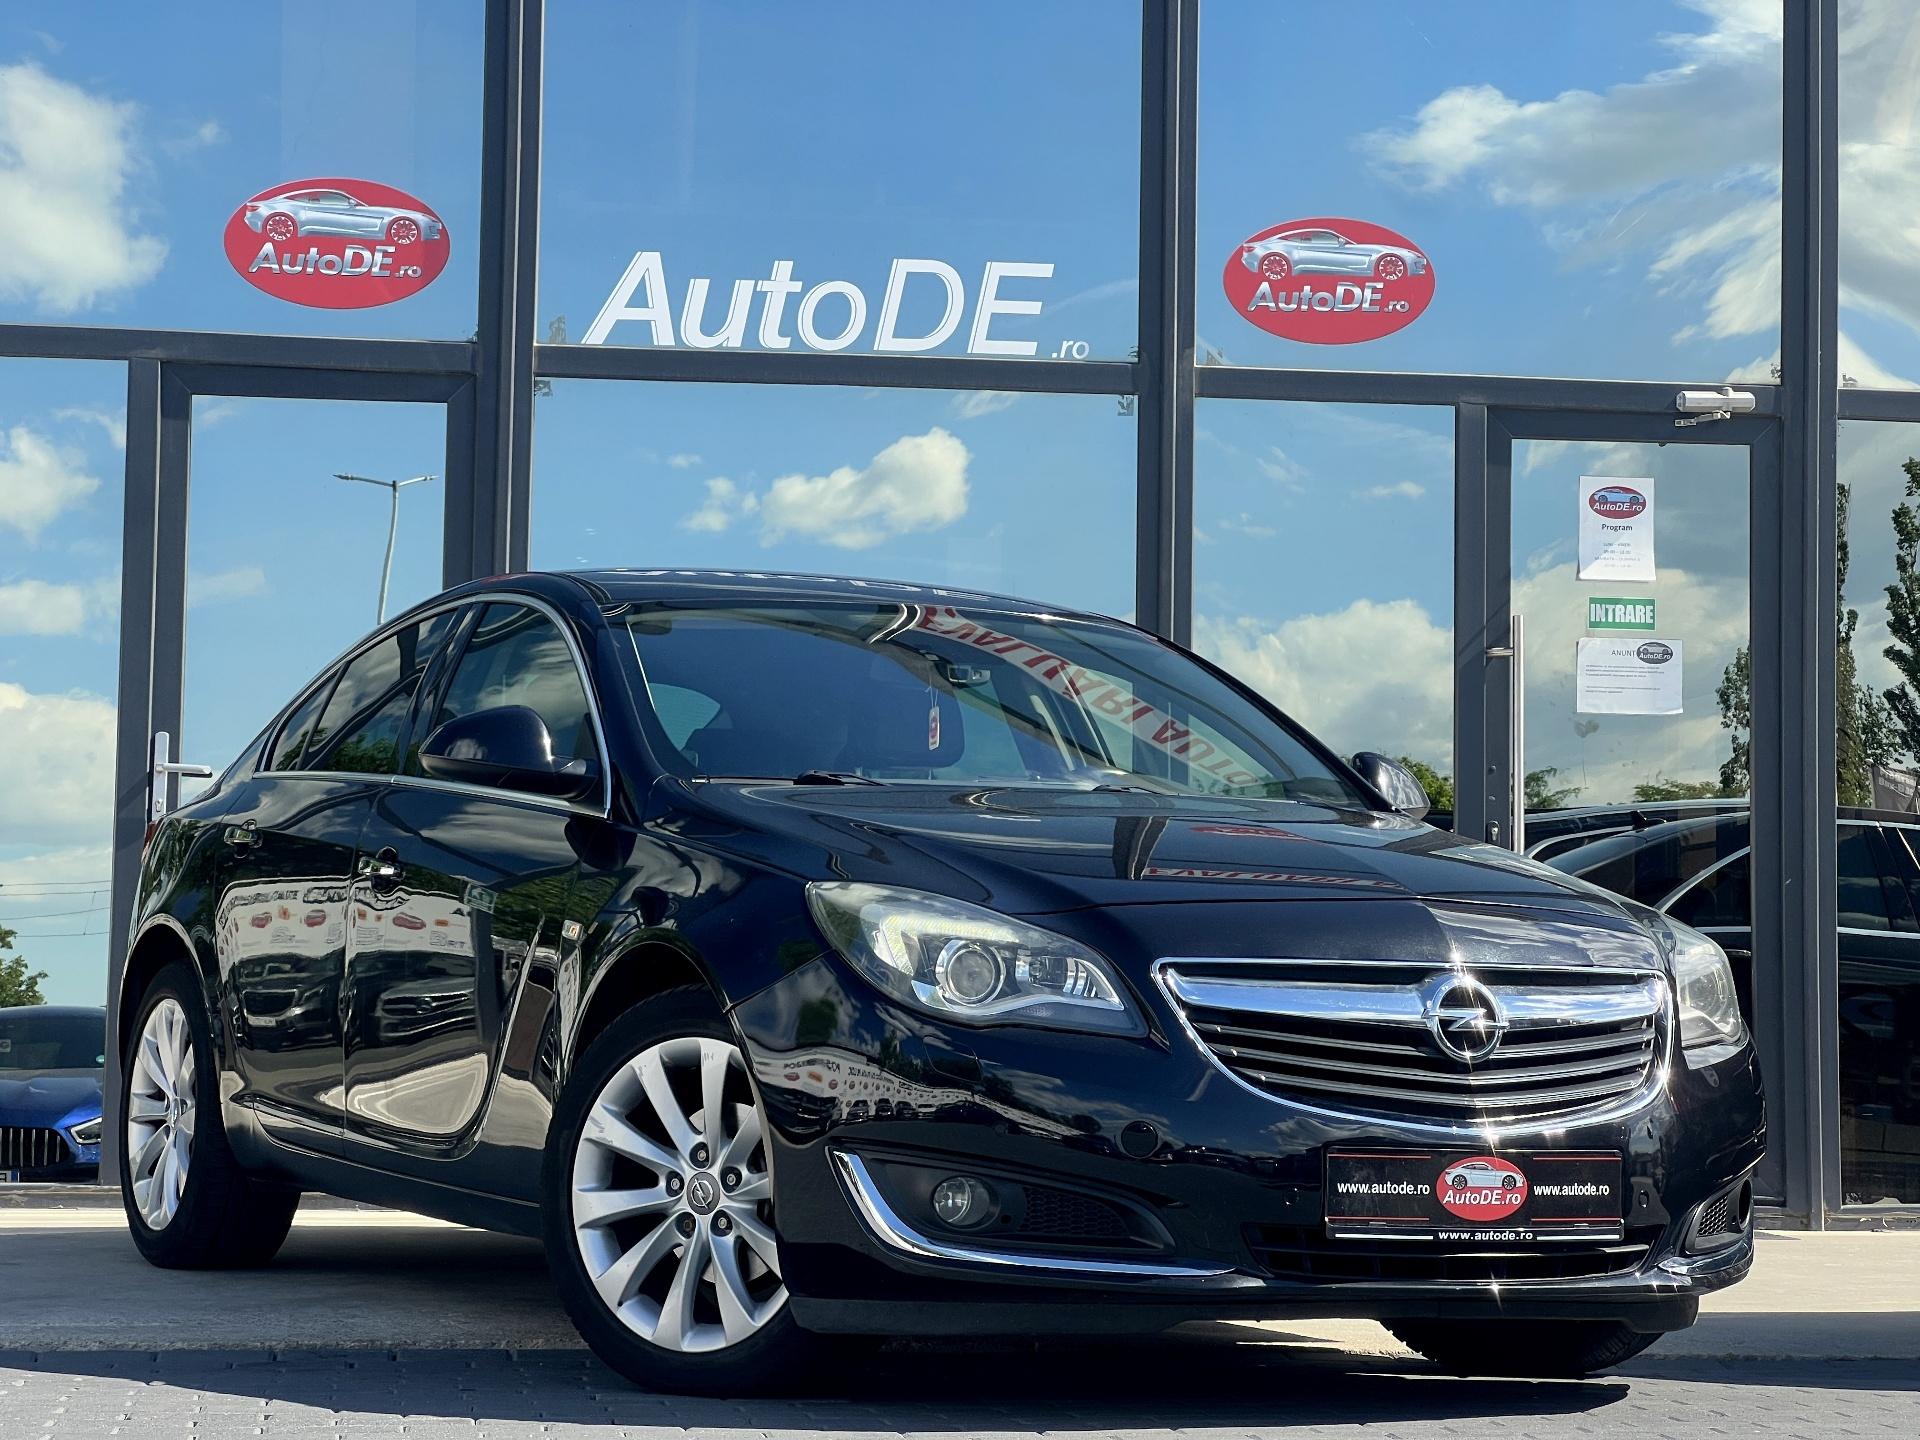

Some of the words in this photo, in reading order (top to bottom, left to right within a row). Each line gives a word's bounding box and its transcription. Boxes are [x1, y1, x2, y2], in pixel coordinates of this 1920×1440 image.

[248, 242, 422, 278] AutoDE.ro
[1247, 281, 1410, 313] AutoDE.ro
[1593, 502, 1643, 512] AutoDE.ro
[1601, 523, 1633, 533] Program
[1590, 603, 1654, 624] INTRARE
[1639, 652, 1671, 660] AutoDE.ro
[1337, 1180, 1430, 1196] www.autode.ro
[1533, 1182, 1610, 1197] www.autode.ro
[1442, 1189, 1521, 1206] AutoDE.ro
[1438, 1230, 1533, 1241] www.autode.ro
